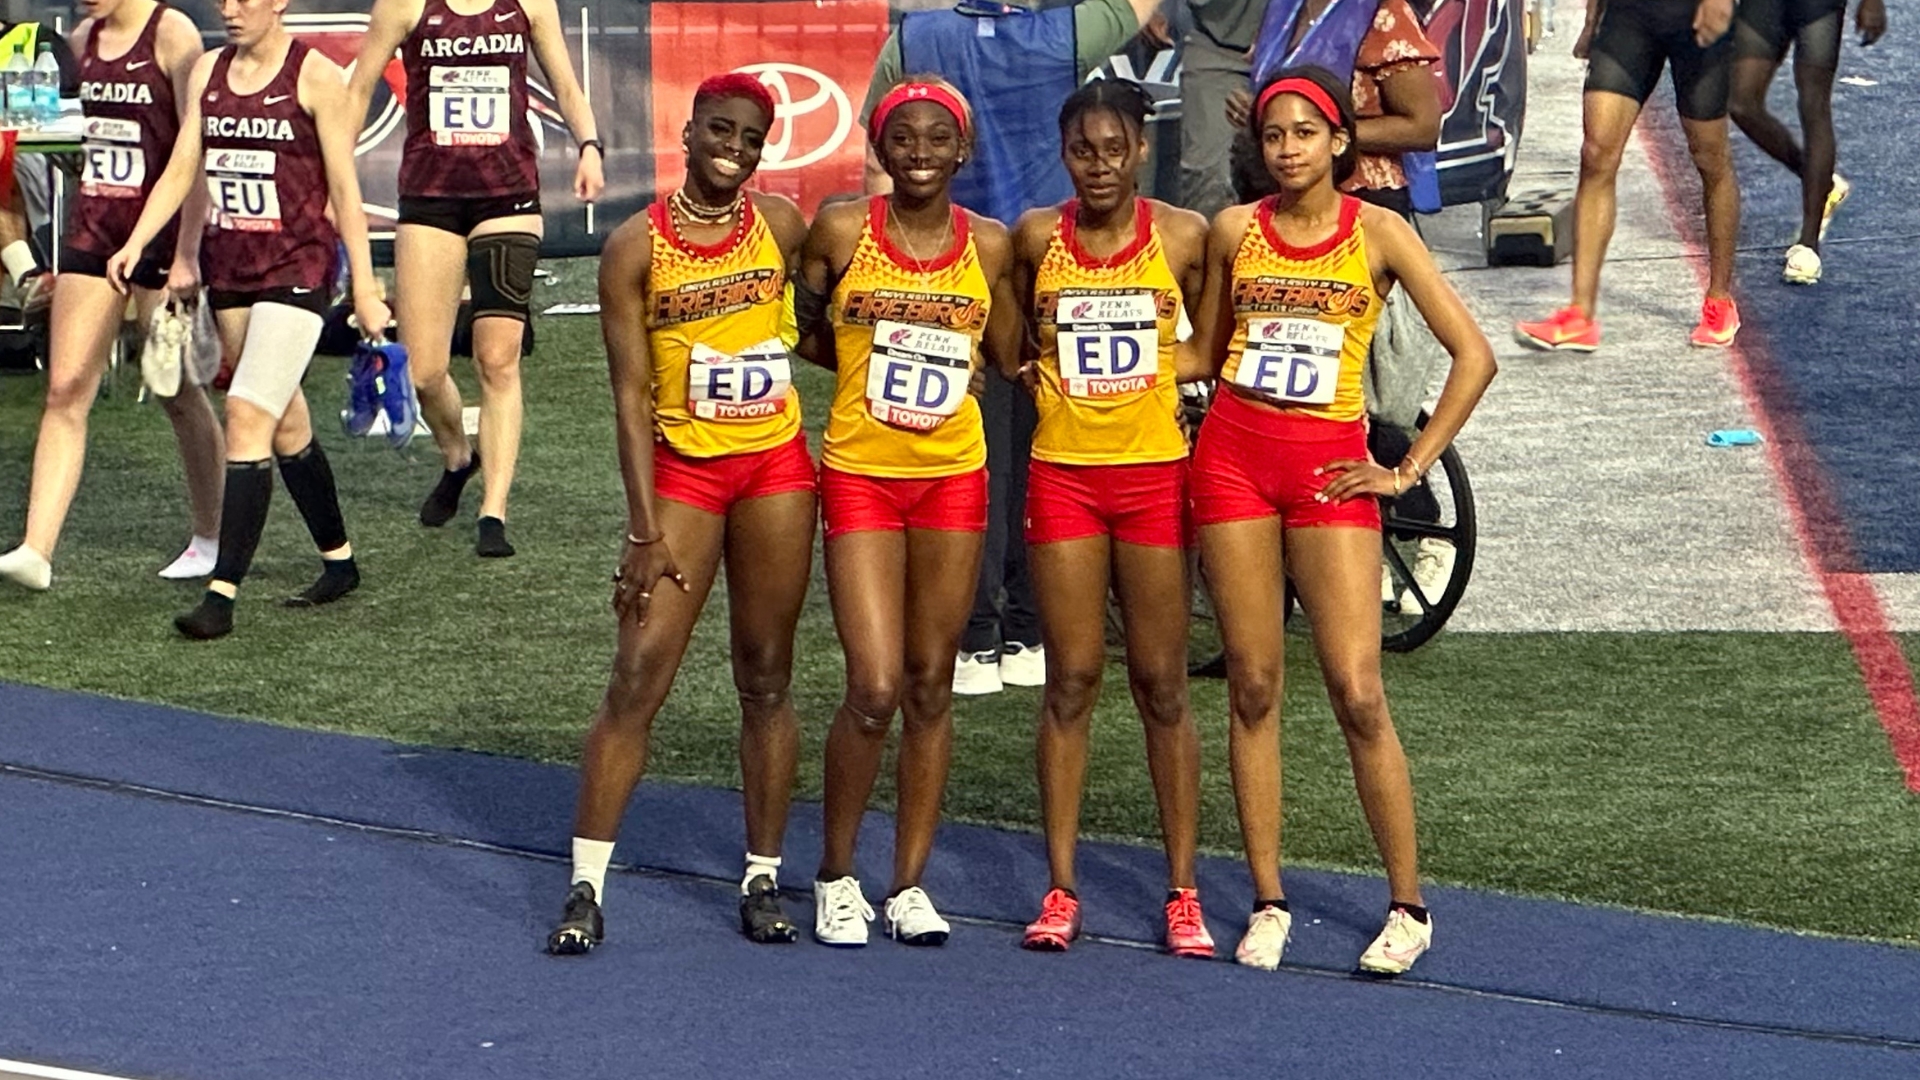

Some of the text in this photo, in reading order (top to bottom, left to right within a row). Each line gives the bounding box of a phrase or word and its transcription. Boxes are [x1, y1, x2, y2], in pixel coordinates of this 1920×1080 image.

[421, 34, 524, 57] ARCADIA
[80, 82, 153, 104] RCADIA
[444, 97, 496, 129] EU
[206, 116, 295, 141] RCADIA
[452, 133, 502, 145] TOYOTA
[90, 149, 133, 181] EU
[219, 181, 265, 215] EU
[1098, 309, 1143, 319] RELAYS
[1100, 301, 1131, 309] PENN
[918, 332, 951, 344] PENN
[1076, 336, 1140, 375] ED
[707, 366, 773, 401] ED
[882, 361, 949, 408] ED
[1089, 378, 1148, 395] TOYOTA
[1253, 355, 1319, 398] ED
[717, 402, 777, 417] TOYOTA
